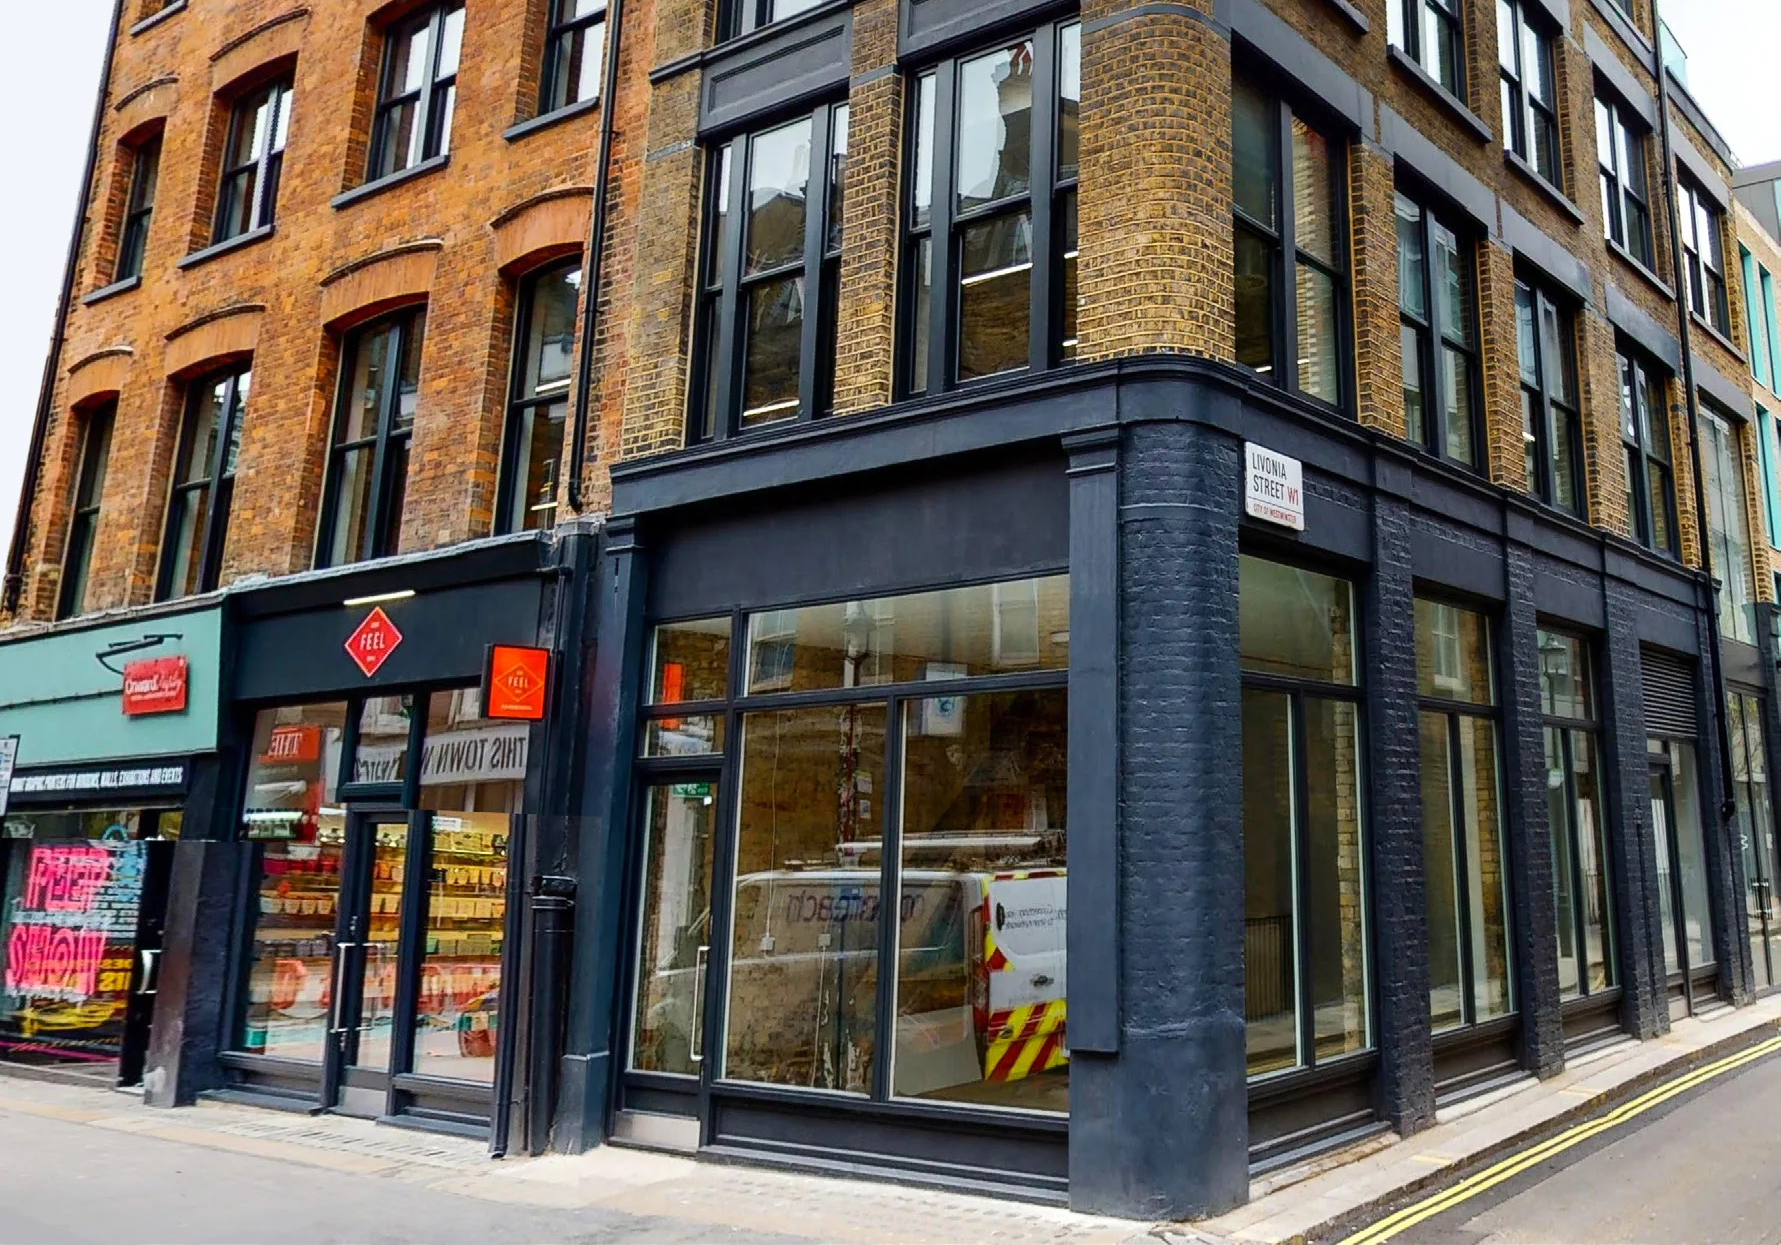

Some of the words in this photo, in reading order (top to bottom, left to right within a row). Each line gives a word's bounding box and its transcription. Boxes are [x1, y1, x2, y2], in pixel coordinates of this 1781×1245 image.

[1252, 452, 1287, 480] LIVONIA
[1253, 474, 1285, 501] STREET
[1287, 485, 1299, 506] W1
[360, 631, 385, 651] FEEL
[508, 675, 529, 689] FEEL
